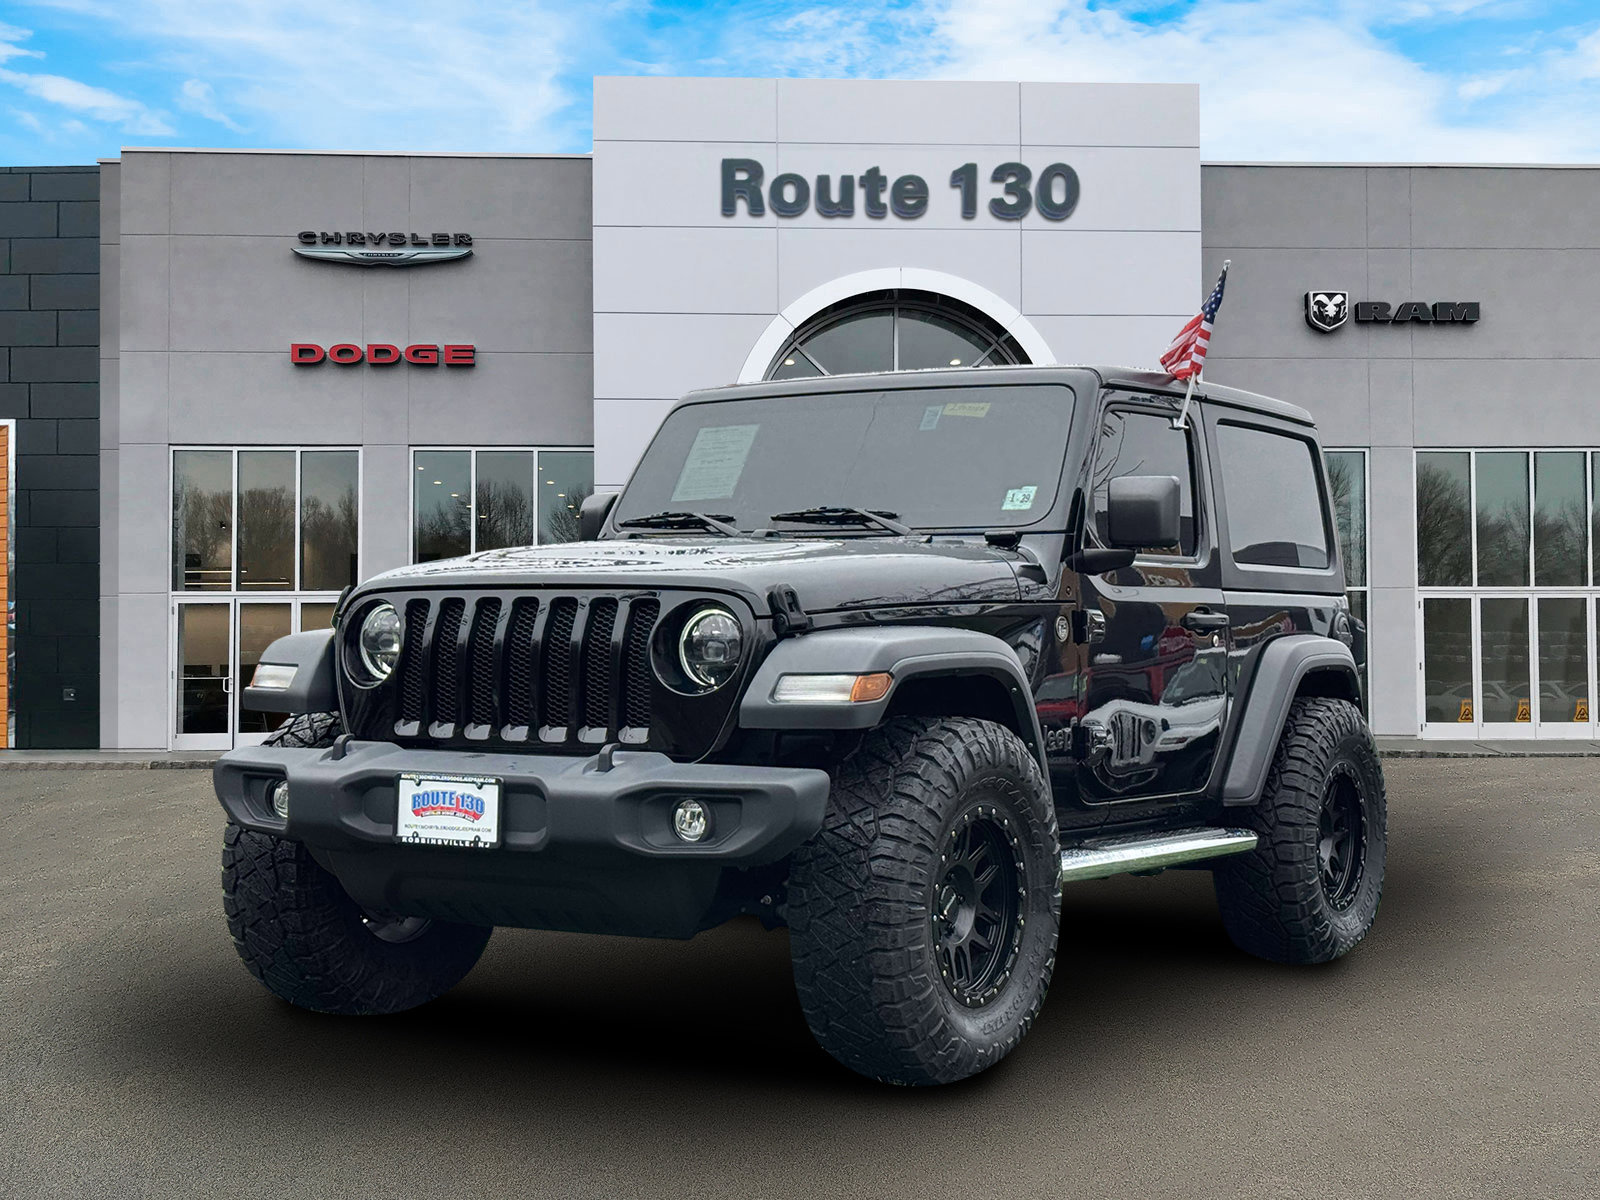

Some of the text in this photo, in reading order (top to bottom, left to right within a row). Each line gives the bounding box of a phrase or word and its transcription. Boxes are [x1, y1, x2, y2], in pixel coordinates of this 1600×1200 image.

[721, 158, 1080, 220] Route 130
[298, 231, 473, 245] CHRYSLER
[1354, 302, 1480, 322] RAM
[291, 343, 475, 365] DODGE
[412, 790, 485, 814] ROUTE 130
[478, 840, 490, 848] NJ
